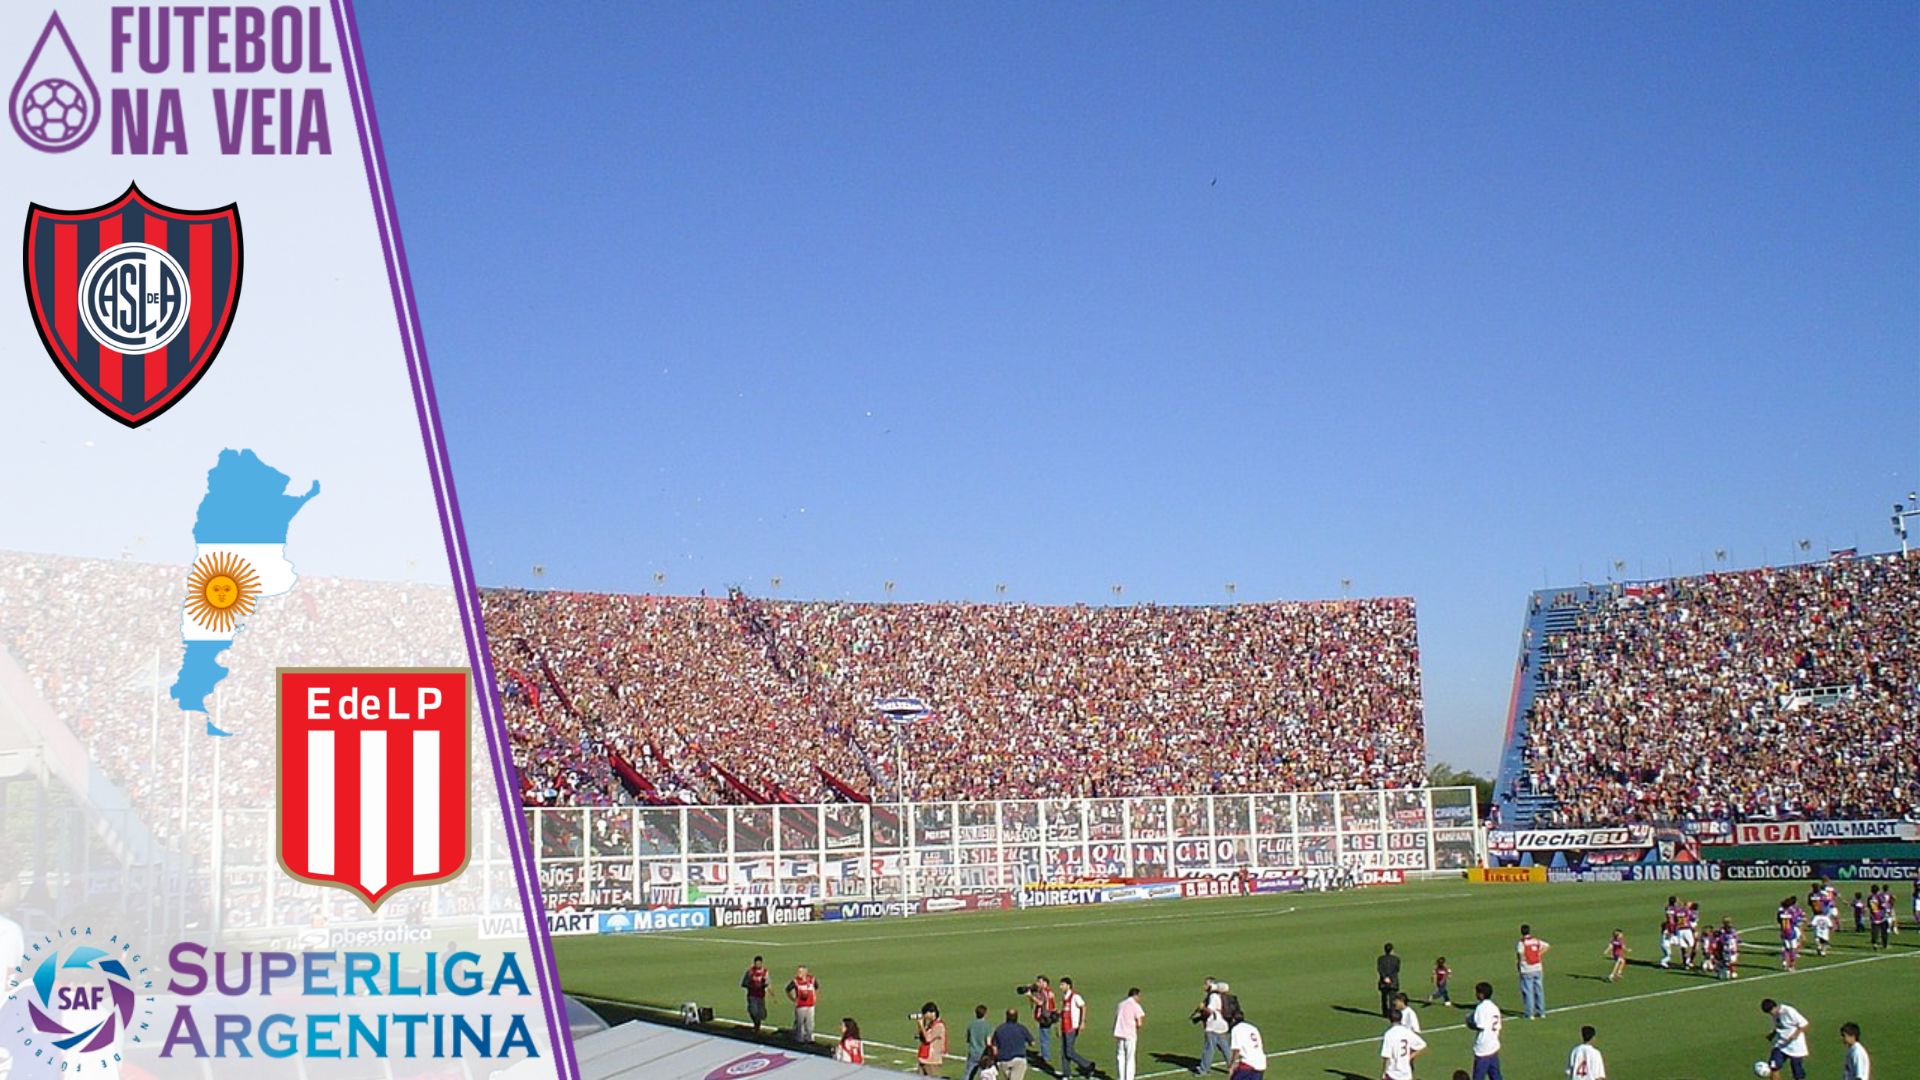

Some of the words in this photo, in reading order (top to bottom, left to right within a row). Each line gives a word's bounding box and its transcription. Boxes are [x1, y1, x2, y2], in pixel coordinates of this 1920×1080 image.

[1744, 825, 1801, 842] RCA
[1632, 864, 1722, 880] SAMSUNG
[1727, 865, 1812, 880] CREDICOOP
[1033, 888, 1097, 905] DIRECTV
[633, 910, 705, 930] Macro
[714, 907, 763, 926] Venier
[766, 904, 812, 925] Venier
[1491, 1015, 1500, 1031] 2
[1400, 1039, 1408, 1057] 3
[1576, 1060, 1588, 1077] 4
